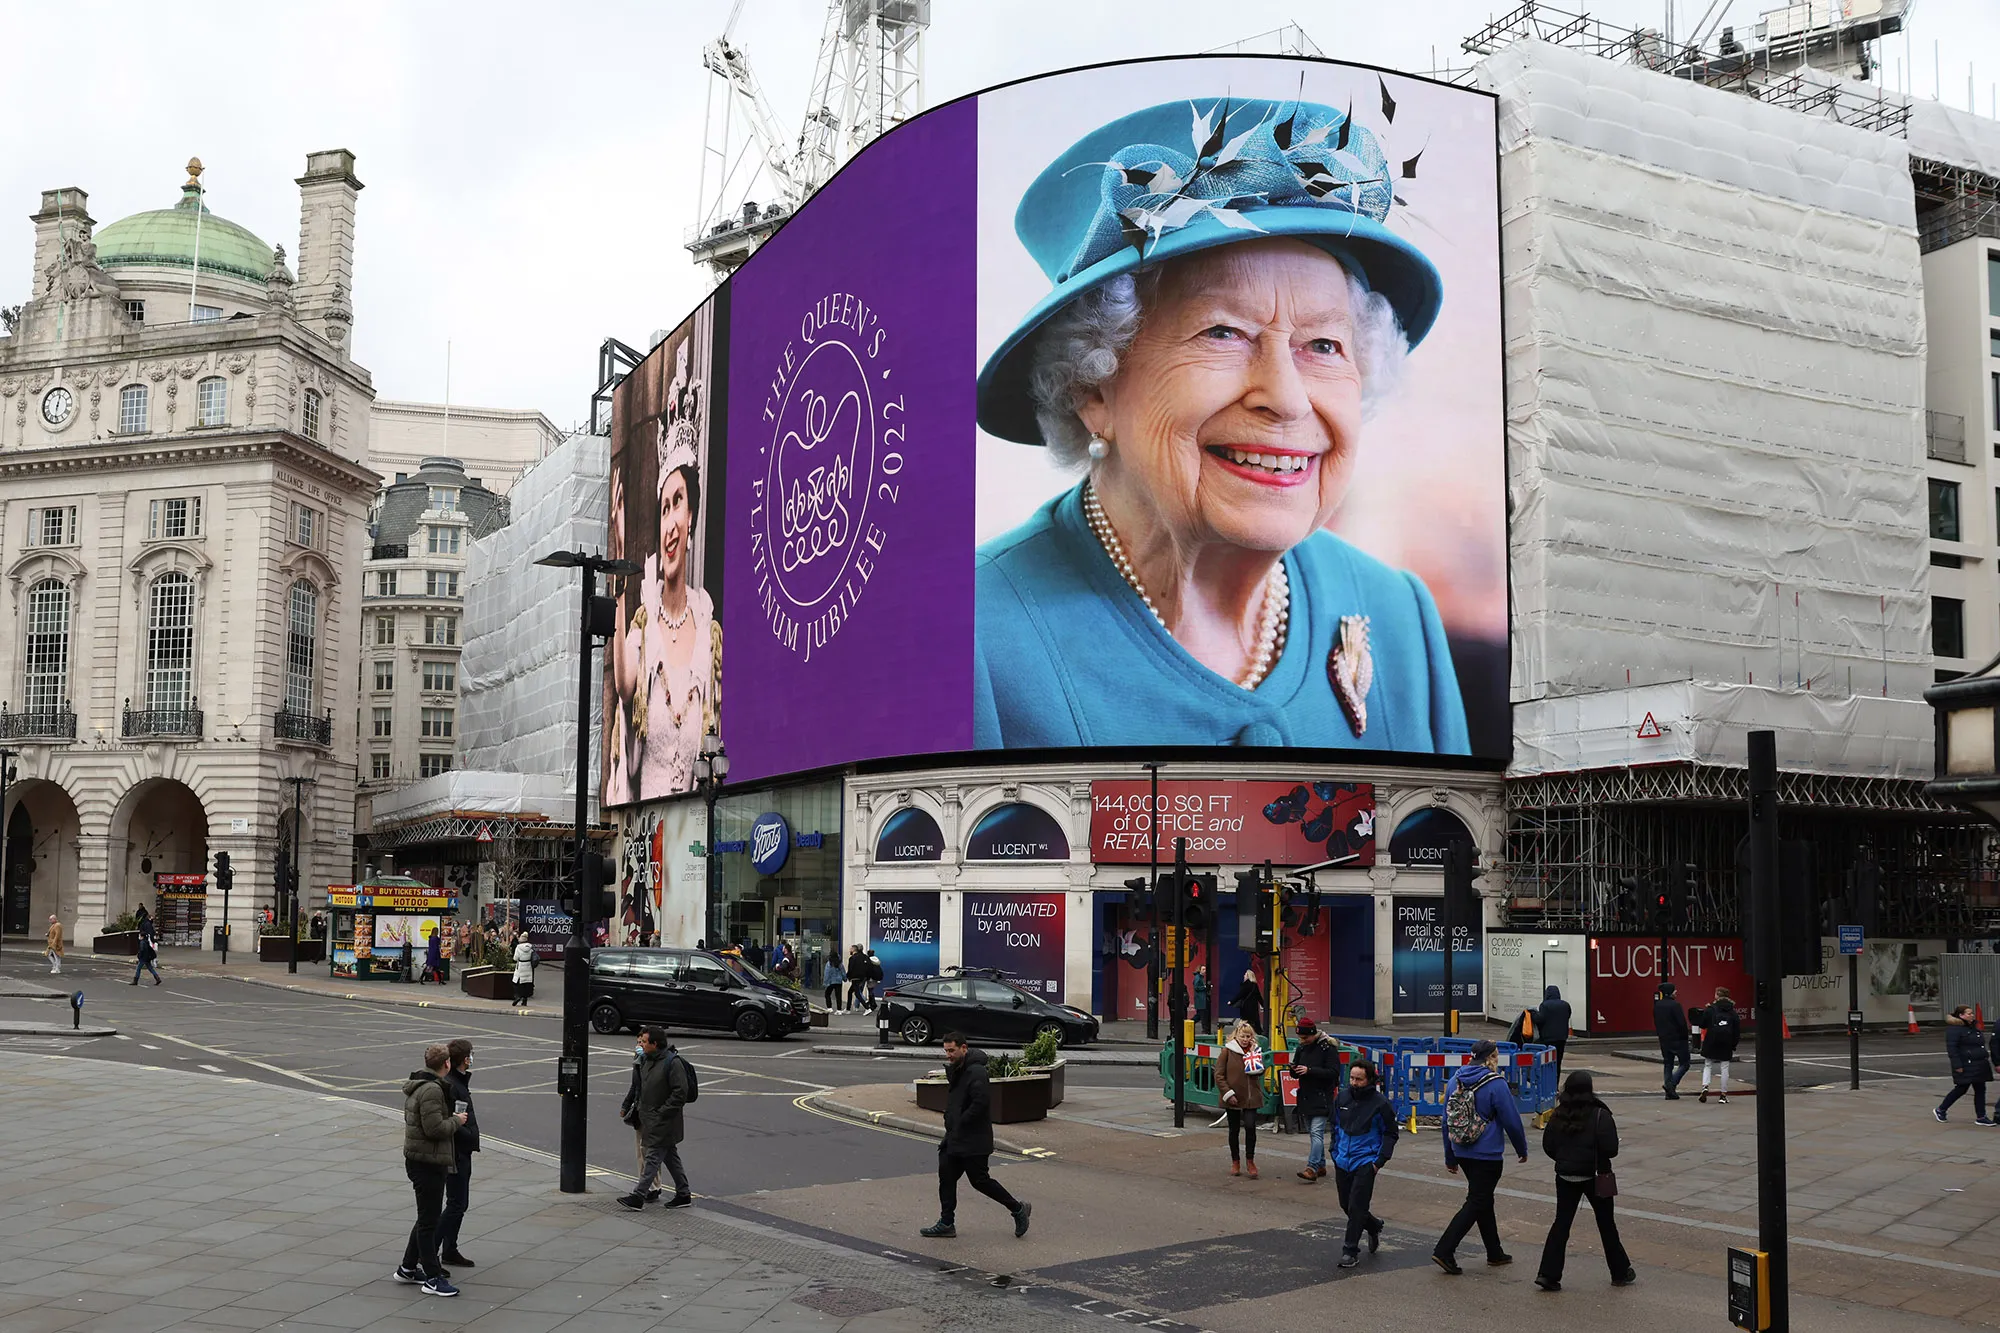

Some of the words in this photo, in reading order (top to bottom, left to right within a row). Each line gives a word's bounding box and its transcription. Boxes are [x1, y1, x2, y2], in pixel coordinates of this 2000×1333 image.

[762, 342, 796, 425] THE
[801, 292, 887, 359] QUEEN'S
[276, 470, 304, 490] ALLIANCE
[308, 484, 320, 497] LIFE
[324, 491, 342, 507] OFFICE
[750, 478, 799, 652] PLATINUM
[804, 522, 887, 663] JUBILEE
[878, 394, 905, 503] 2022
[92, 743, 147, 752] ALLIANCE
[1174, 795, 1203, 812] SQ
[1209, 795, 1232, 812] FT
[1113, 814, 1131, 831] of
[1208, 815, 1244, 832] and
[752, 822, 781, 863] Boots
[796, 830, 823, 849] beauty
[1103, 833, 1165, 850] RETAL
[894, 845, 926, 857] LUCENT
[992, 844, 1037, 855] LUCENT
[379, 887, 392, 895] BUY
[394, 888, 421, 896] TICKETS
[335, 896, 353, 904] HOTDOG
[393, 898, 429, 906] HOTDOG
[526, 905, 555, 915] PRIME
[875, 901, 902, 914] PRIME
[970, 903, 1057, 917] ILLUMINATED
[1398, 907, 1436, 921] PRIME
[526, 916, 546, 924] retail
[879, 916, 899, 929] retail
[900, 918, 928, 931] space
[978, 918, 993, 932] by
[995, 920, 1011, 931] an
[529, 925, 573, 935] AVAILABL
[882, 930, 933, 944] AVAILABLE
[1405, 923, 1431, 937] retail
[1006, 933, 1041, 947] ICON
[1411, 938, 1474, 952] AVAILBLE
[1491, 938, 1522, 947] COMING
[1491, 947, 1500, 956] Q1
[1501, 948, 1520, 957] 2023
[1596, 945, 1708, 978] LUCENT
[1713, 945, 1735, 961] W1
[1793, 976, 1843, 990] DAYLIGHT
